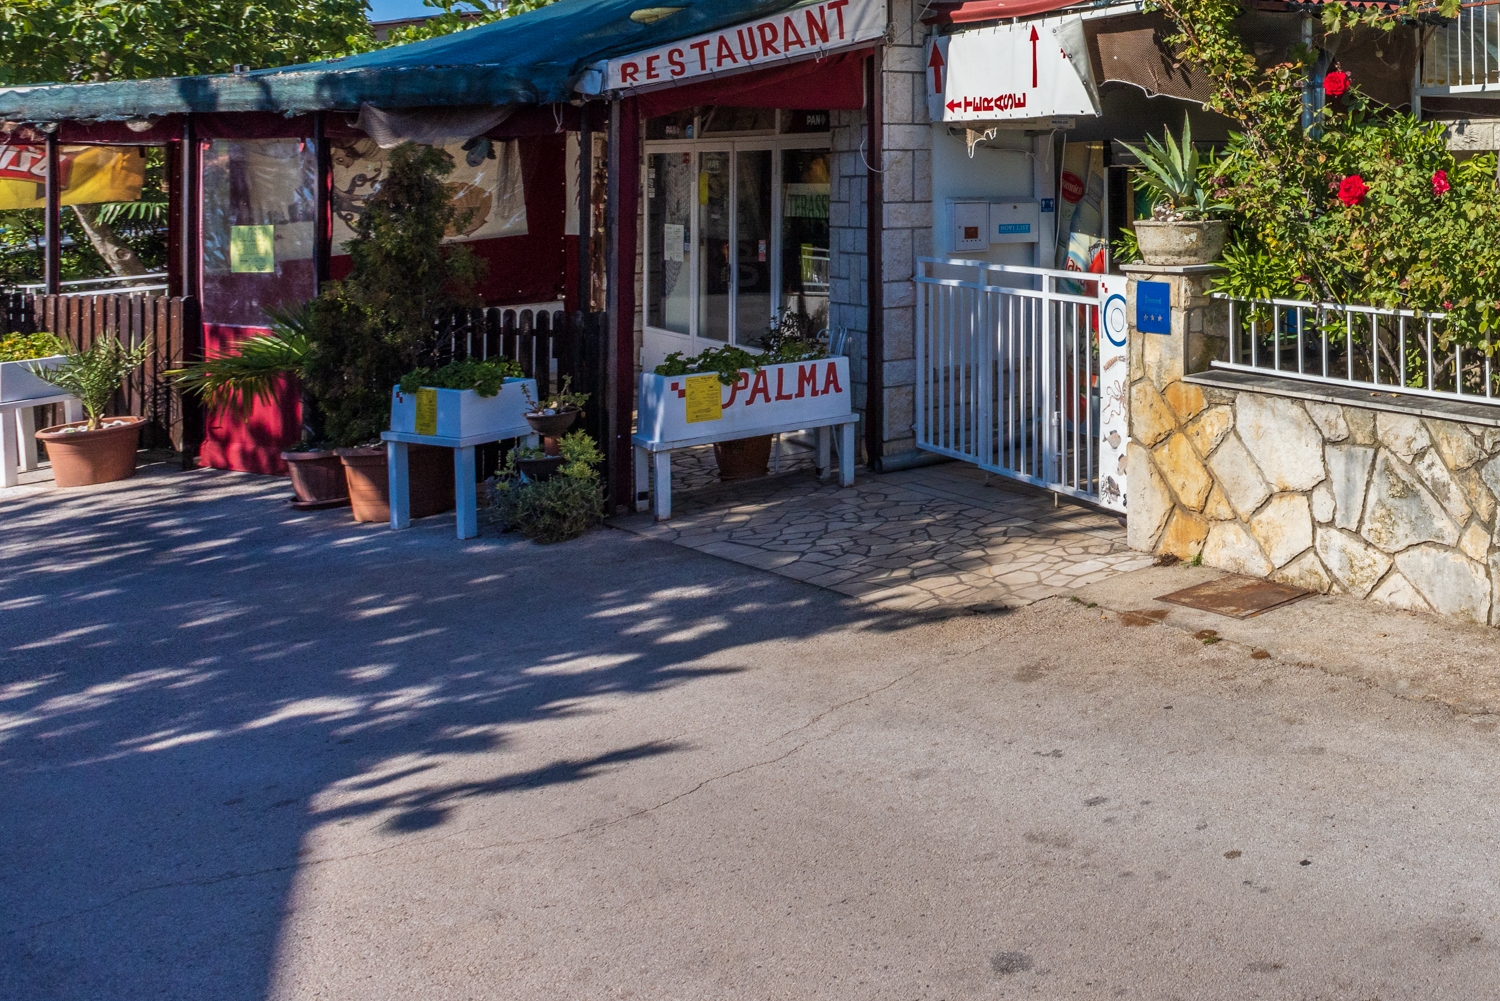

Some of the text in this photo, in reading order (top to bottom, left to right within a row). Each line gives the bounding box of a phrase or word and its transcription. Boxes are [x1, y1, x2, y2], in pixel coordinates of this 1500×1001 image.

[963, 92, 1027, 113] TERASE
[806, 114, 821, 126] PAN
[722, 361, 843, 409] PALMA
